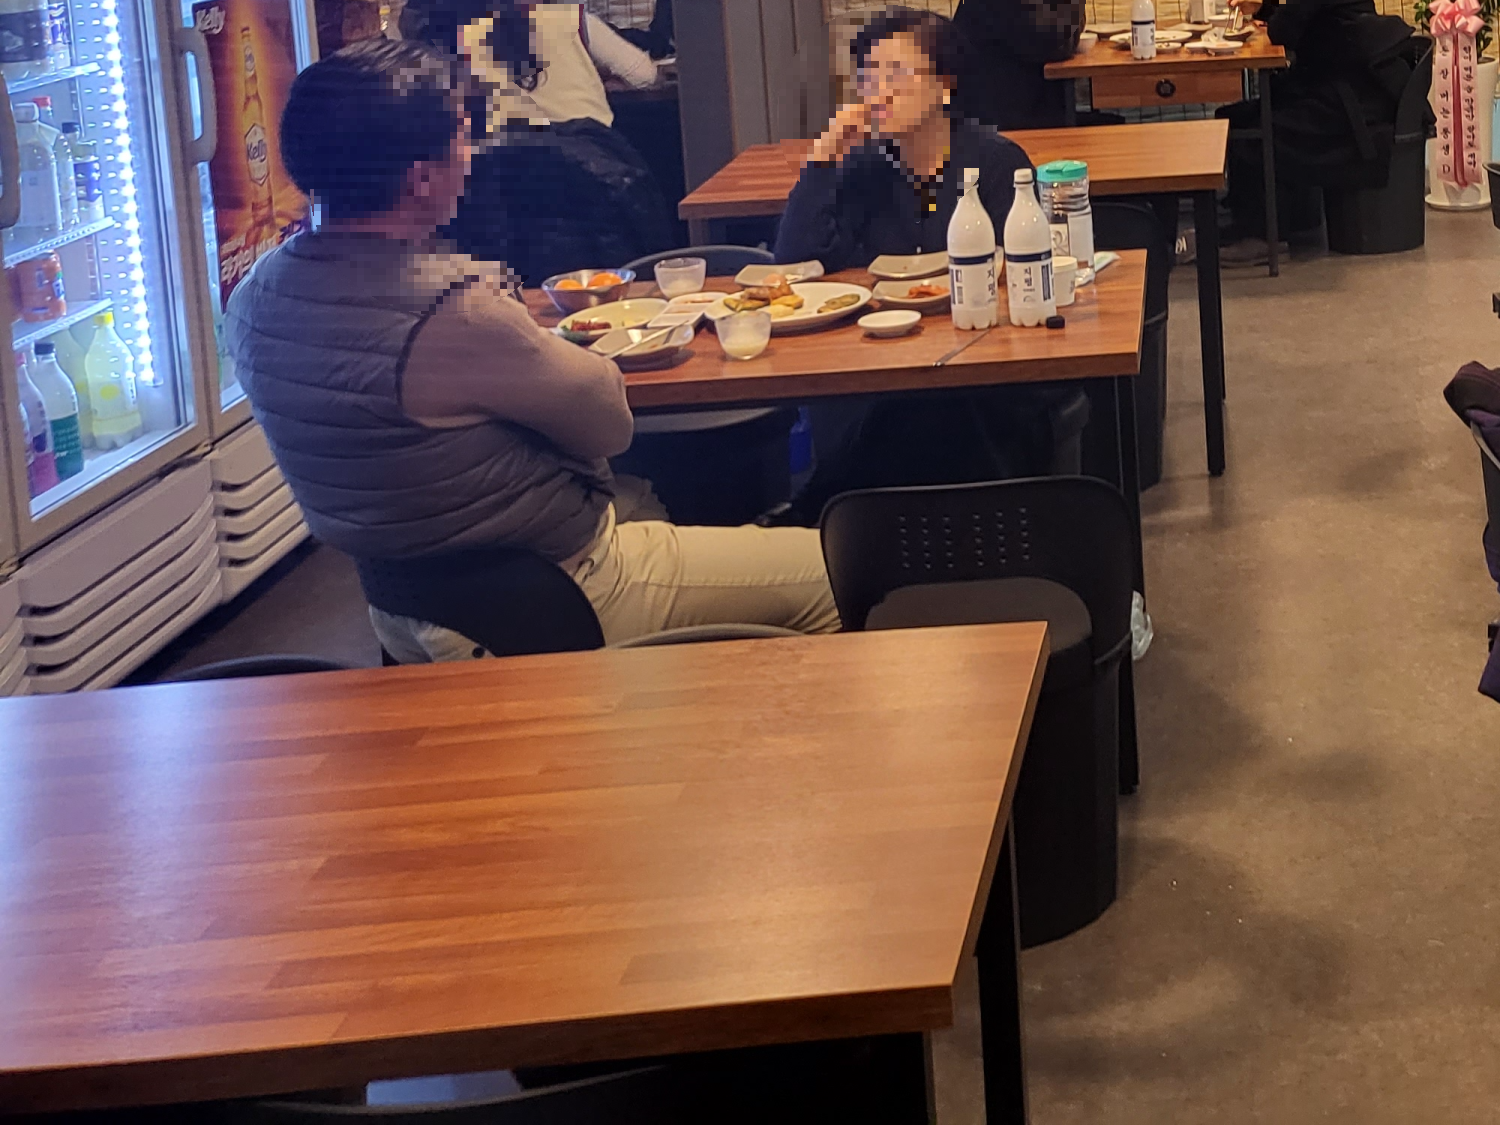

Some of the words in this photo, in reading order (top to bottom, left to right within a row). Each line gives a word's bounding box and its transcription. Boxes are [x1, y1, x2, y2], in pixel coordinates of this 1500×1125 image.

[195, 6, 226, 35] Kelly
[246, 138, 267, 163] Kelly
[1023, 266, 1033, 287] 지평
